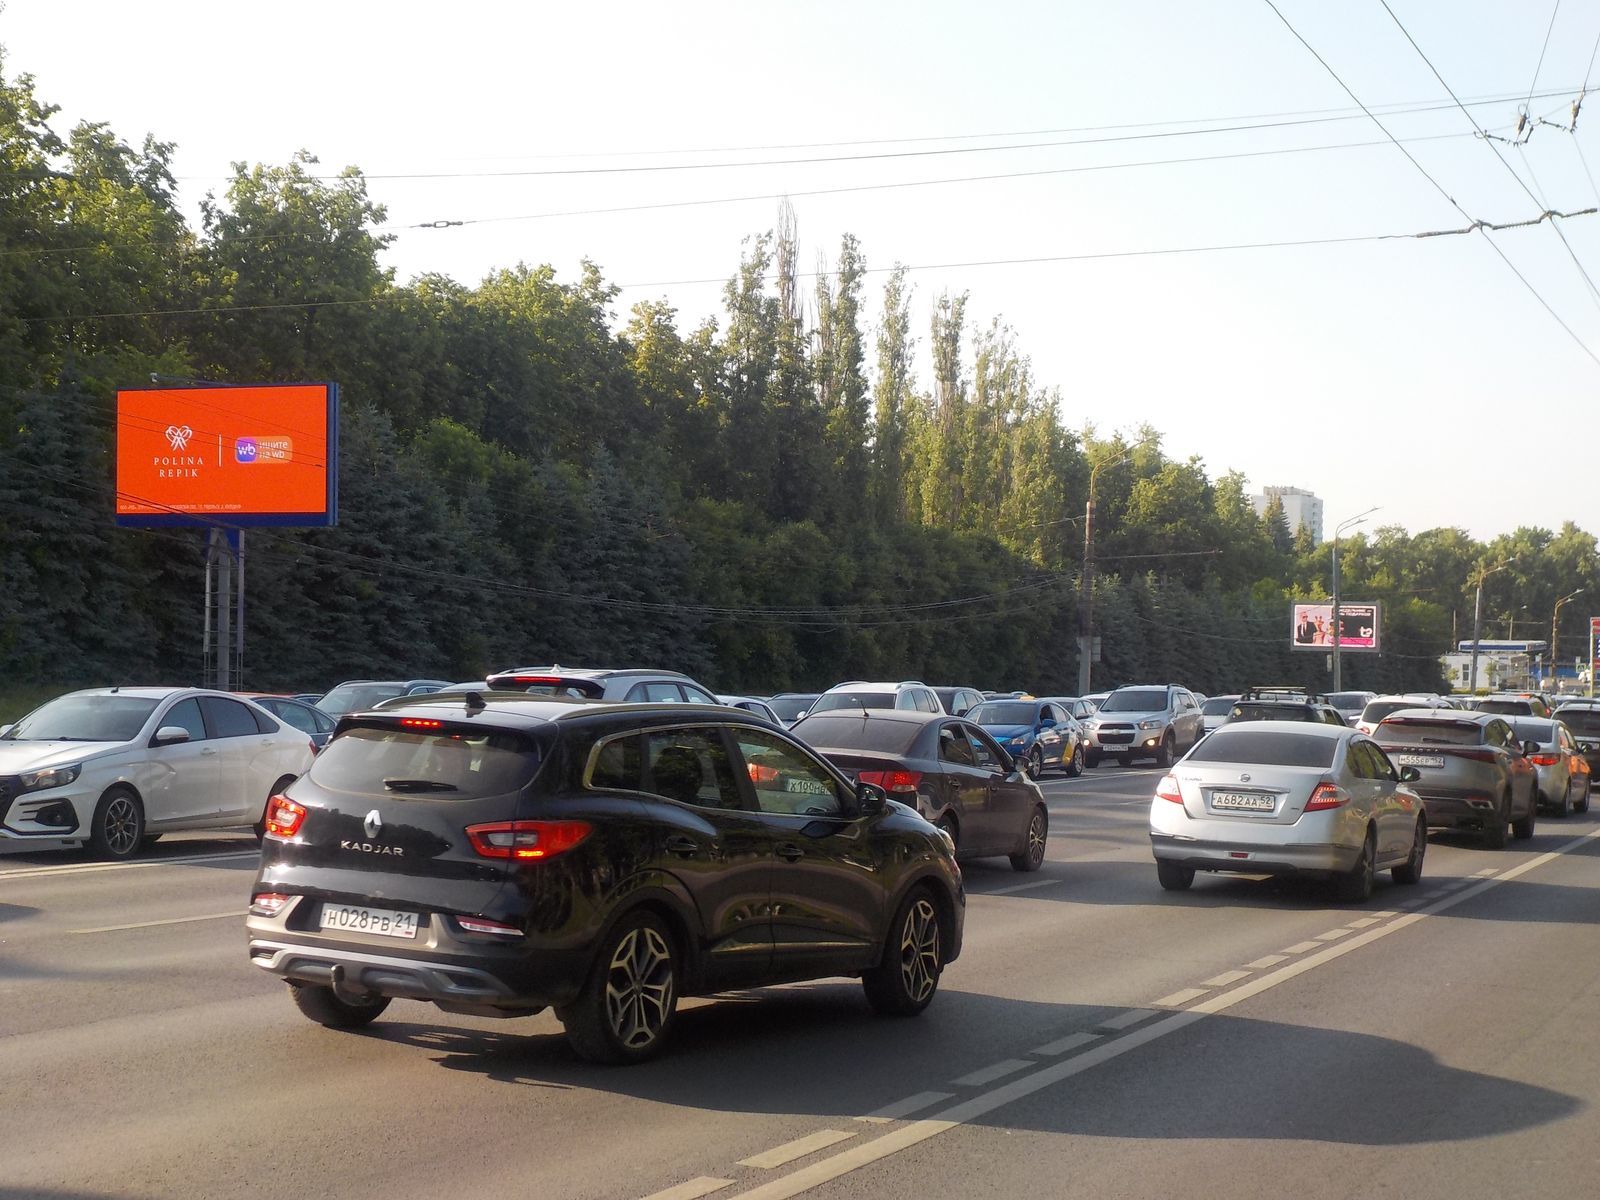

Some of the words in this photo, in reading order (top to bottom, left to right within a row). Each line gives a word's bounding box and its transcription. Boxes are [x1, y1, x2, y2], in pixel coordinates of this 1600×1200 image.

[238, 443, 256, 456] wb
[153, 456, 203, 466] POLINA
[159, 468, 198, 478] REPIK
[340, 840, 404, 856] KADJAR
